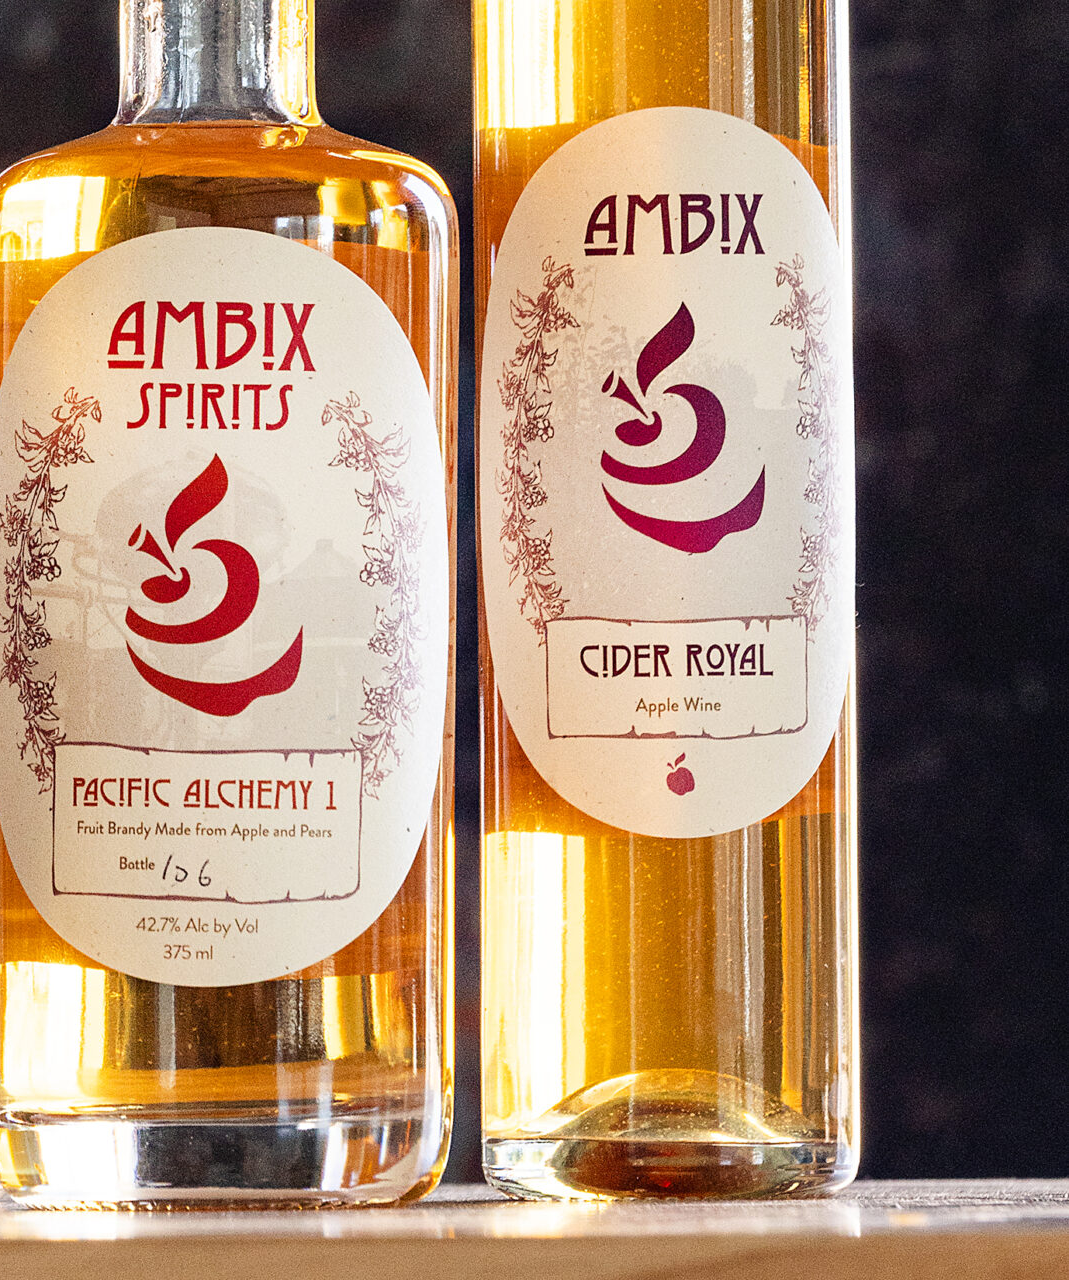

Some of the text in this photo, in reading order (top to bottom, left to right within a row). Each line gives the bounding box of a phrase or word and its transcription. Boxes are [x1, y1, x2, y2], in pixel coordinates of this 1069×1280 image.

[583, 193, 765, 257] AMBIX
[107, 300, 316, 372] AMBIX
[126, 382, 293, 431] SPIRITS
[579, 643, 774, 678] CIDER ROYAL
[635, 696, 722, 718] Apple Wine
[72, 776, 337, 811] PACIFIC ALCHEMY 1
[76, 819, 333, 842] Fruit Brandy Made from Apple and Pears
[119, 855, 156, 871] Bottle
[135, 915, 259, 939] 42.7% Alc by Vol
[163, 943, 214, 960] 375 ml
